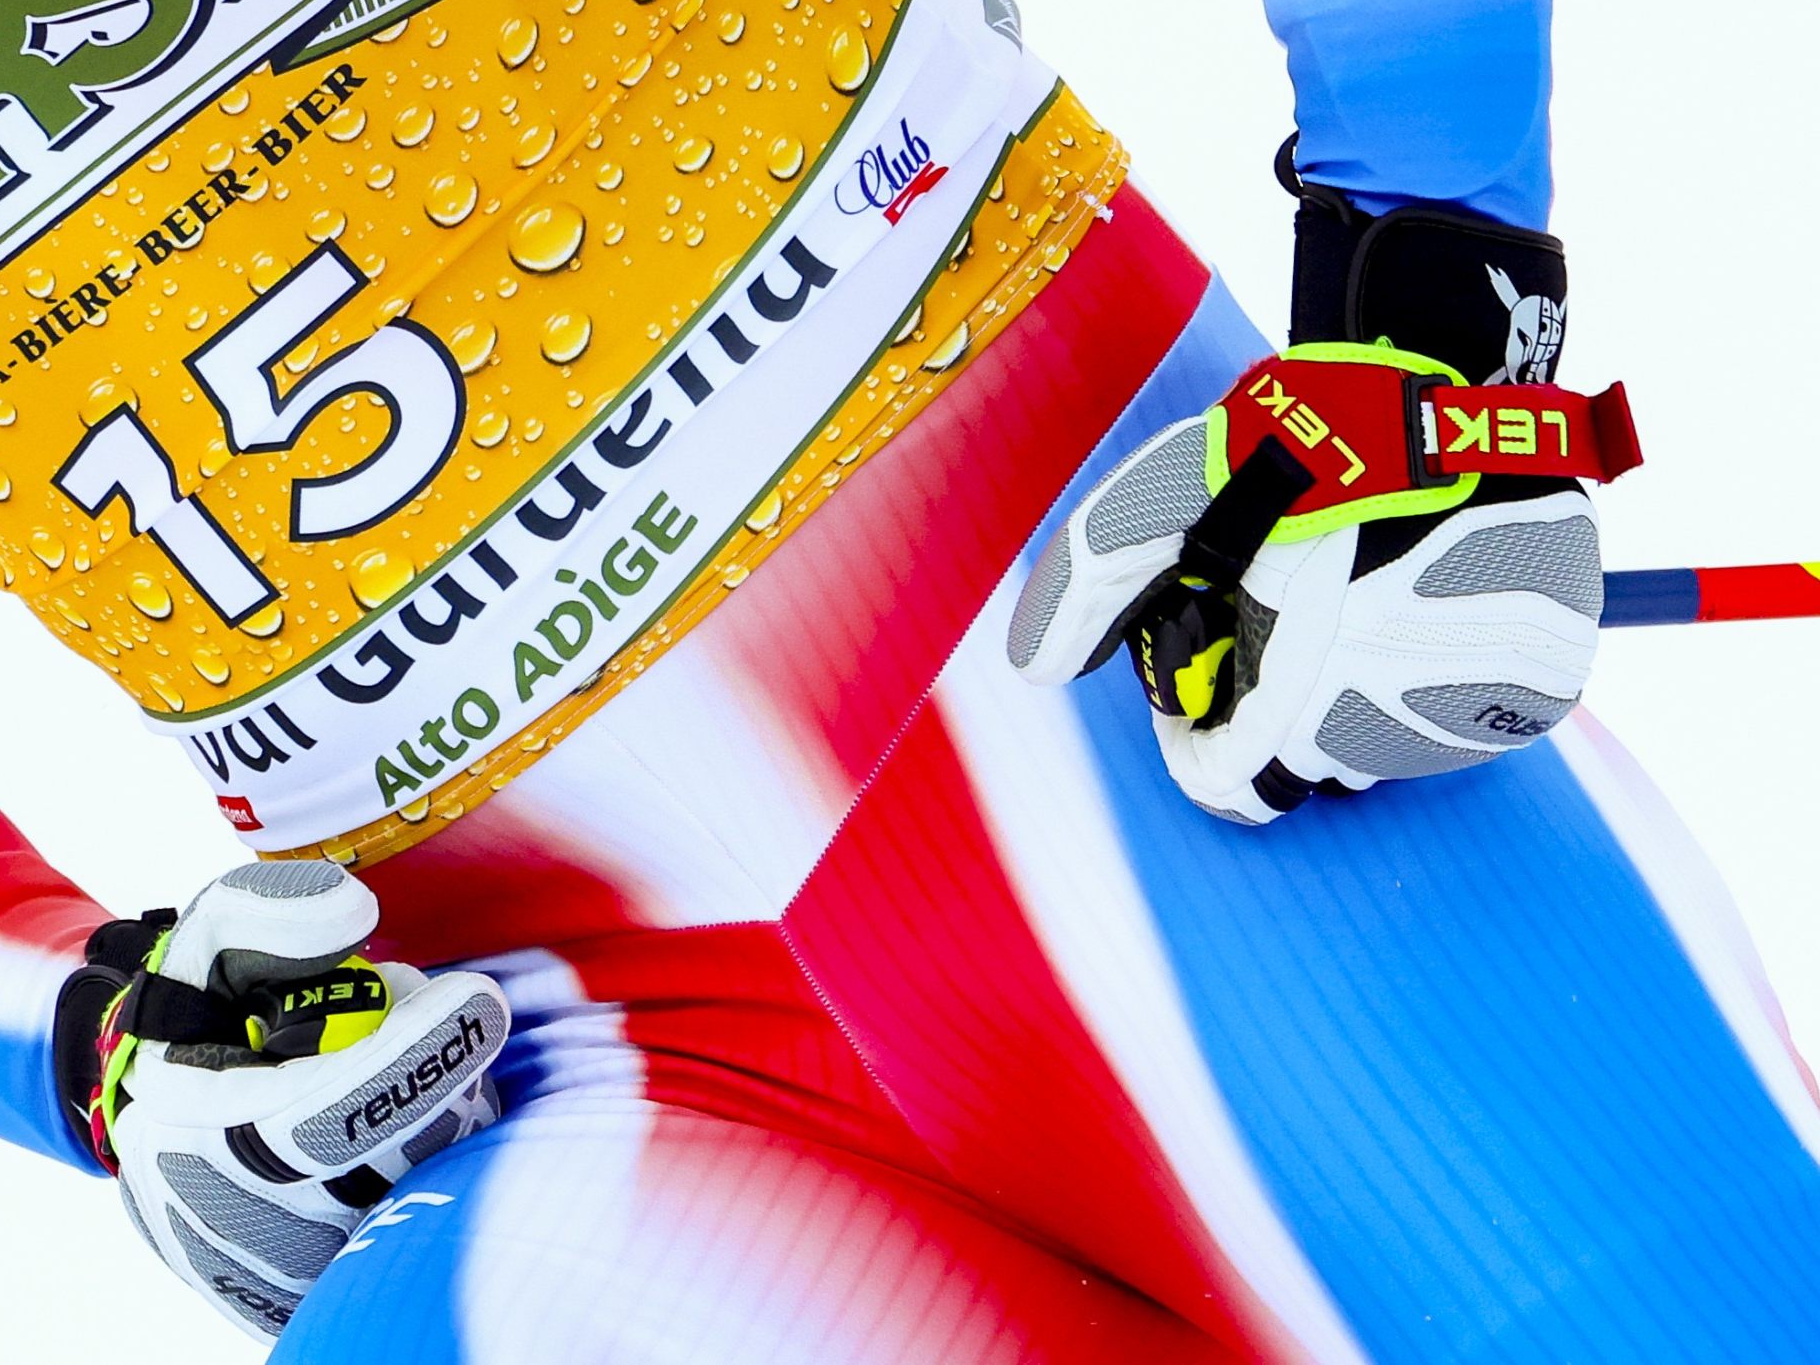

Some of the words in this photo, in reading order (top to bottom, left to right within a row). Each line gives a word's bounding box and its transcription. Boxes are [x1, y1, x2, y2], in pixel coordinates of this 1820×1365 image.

[835, 117, 931, 215] Club
[51, 238, 467, 629] 15
[1247, 373, 1367, 486] LEKI
[283, 981, 381, 1013] LEKI
[343, 1013, 486, 1143] reusch
